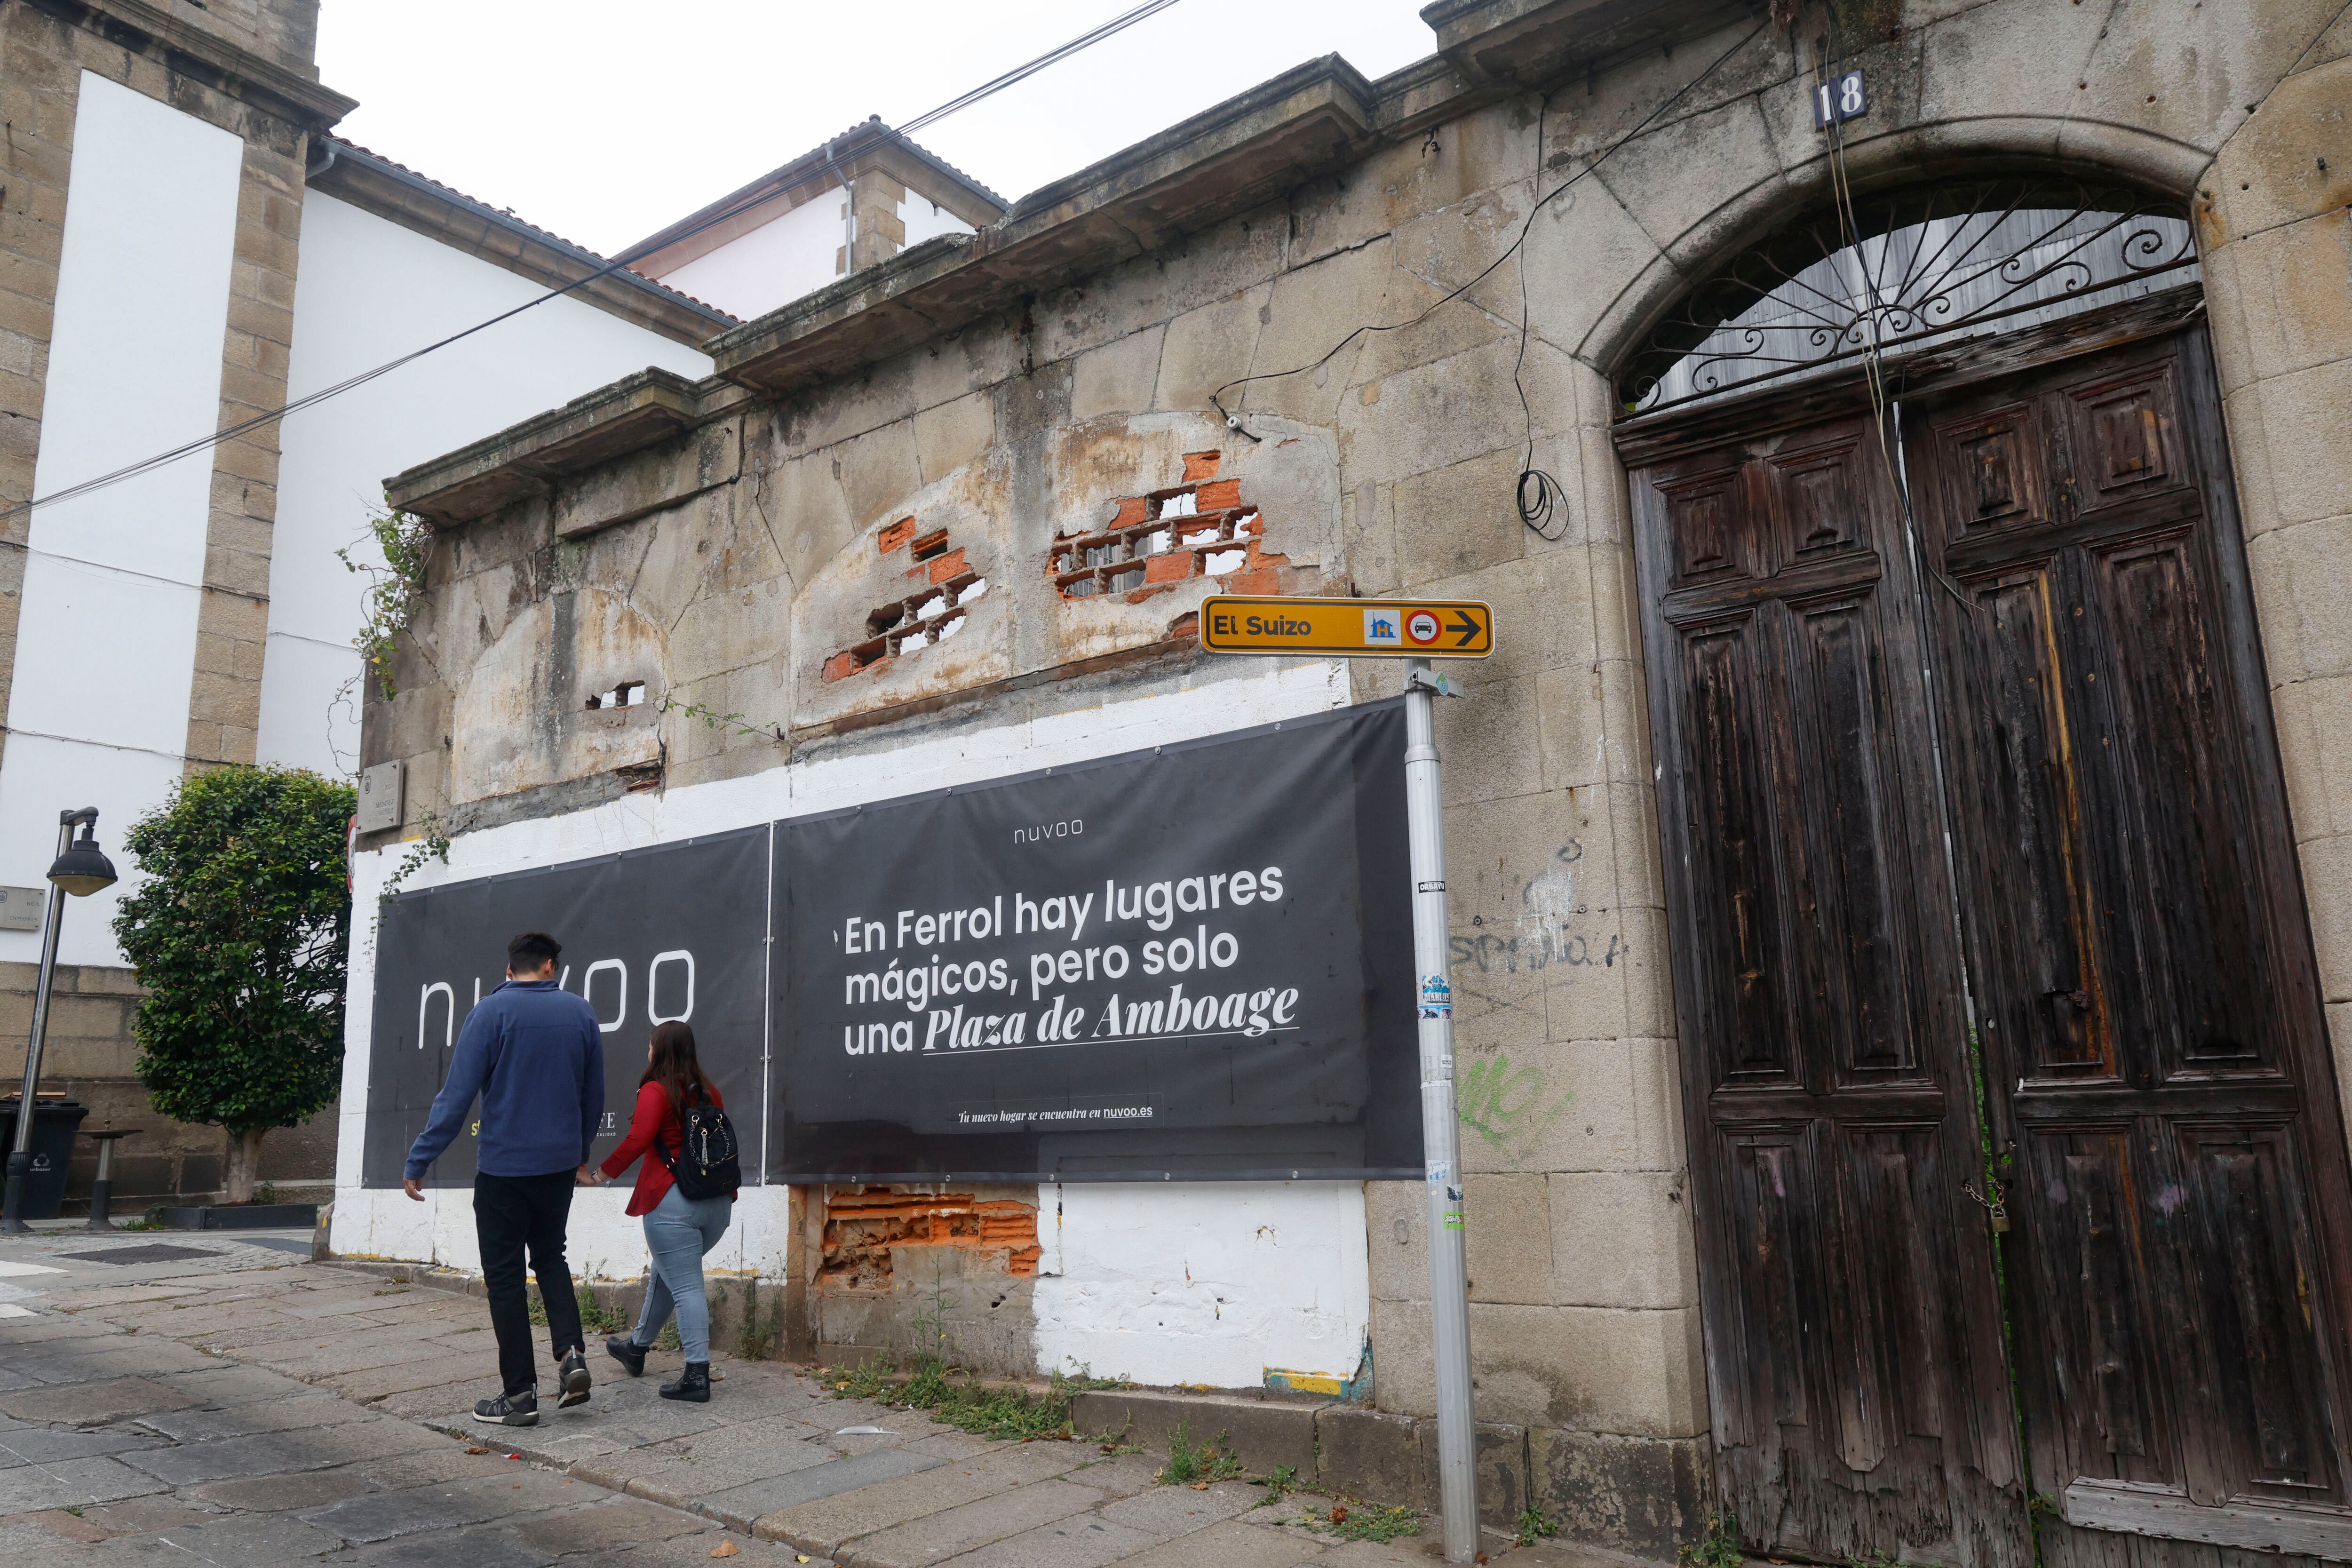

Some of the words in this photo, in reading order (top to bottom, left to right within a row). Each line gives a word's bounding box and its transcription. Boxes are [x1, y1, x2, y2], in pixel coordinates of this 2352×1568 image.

[1821, 76, 1861, 121] 18
[1214, 615, 1239, 635] El
[1246, 614, 1311, 636] Suizo
[1377, 624, 1388, 637] H
[1015, 819, 1083, 844] nuvoo
[845, 916, 885, 954] En
[897, 895, 1002, 948] Ferrol
[1015, 892, 1094, 941] hay
[1105, 867, 1284, 931] lugares
[845, 954, 1018, 1012] mágicos,
[1031, 945, 1129, 1001] pero
[1143, 924, 1239, 975] solo
[418, 949, 694, 1050] noo
[844, 1021, 913, 1056] una
[922, 1003, 1026, 1051] Plaza
[1037, 994, 1085, 1043] de
[1091, 983, 1299, 1038] Amboage
[958, 1110, 969, 1123] Tu
[971, 1114, 998, 1123] nuevo
[1000, 1110, 1026, 1124] hogar
[1028, 1112, 1038, 1121] se
[1039, 1108, 1087, 1120] encuentra
[1089, 1109, 1101, 1118] en
[1103, 1106, 1153, 1118] nuvoo.es
